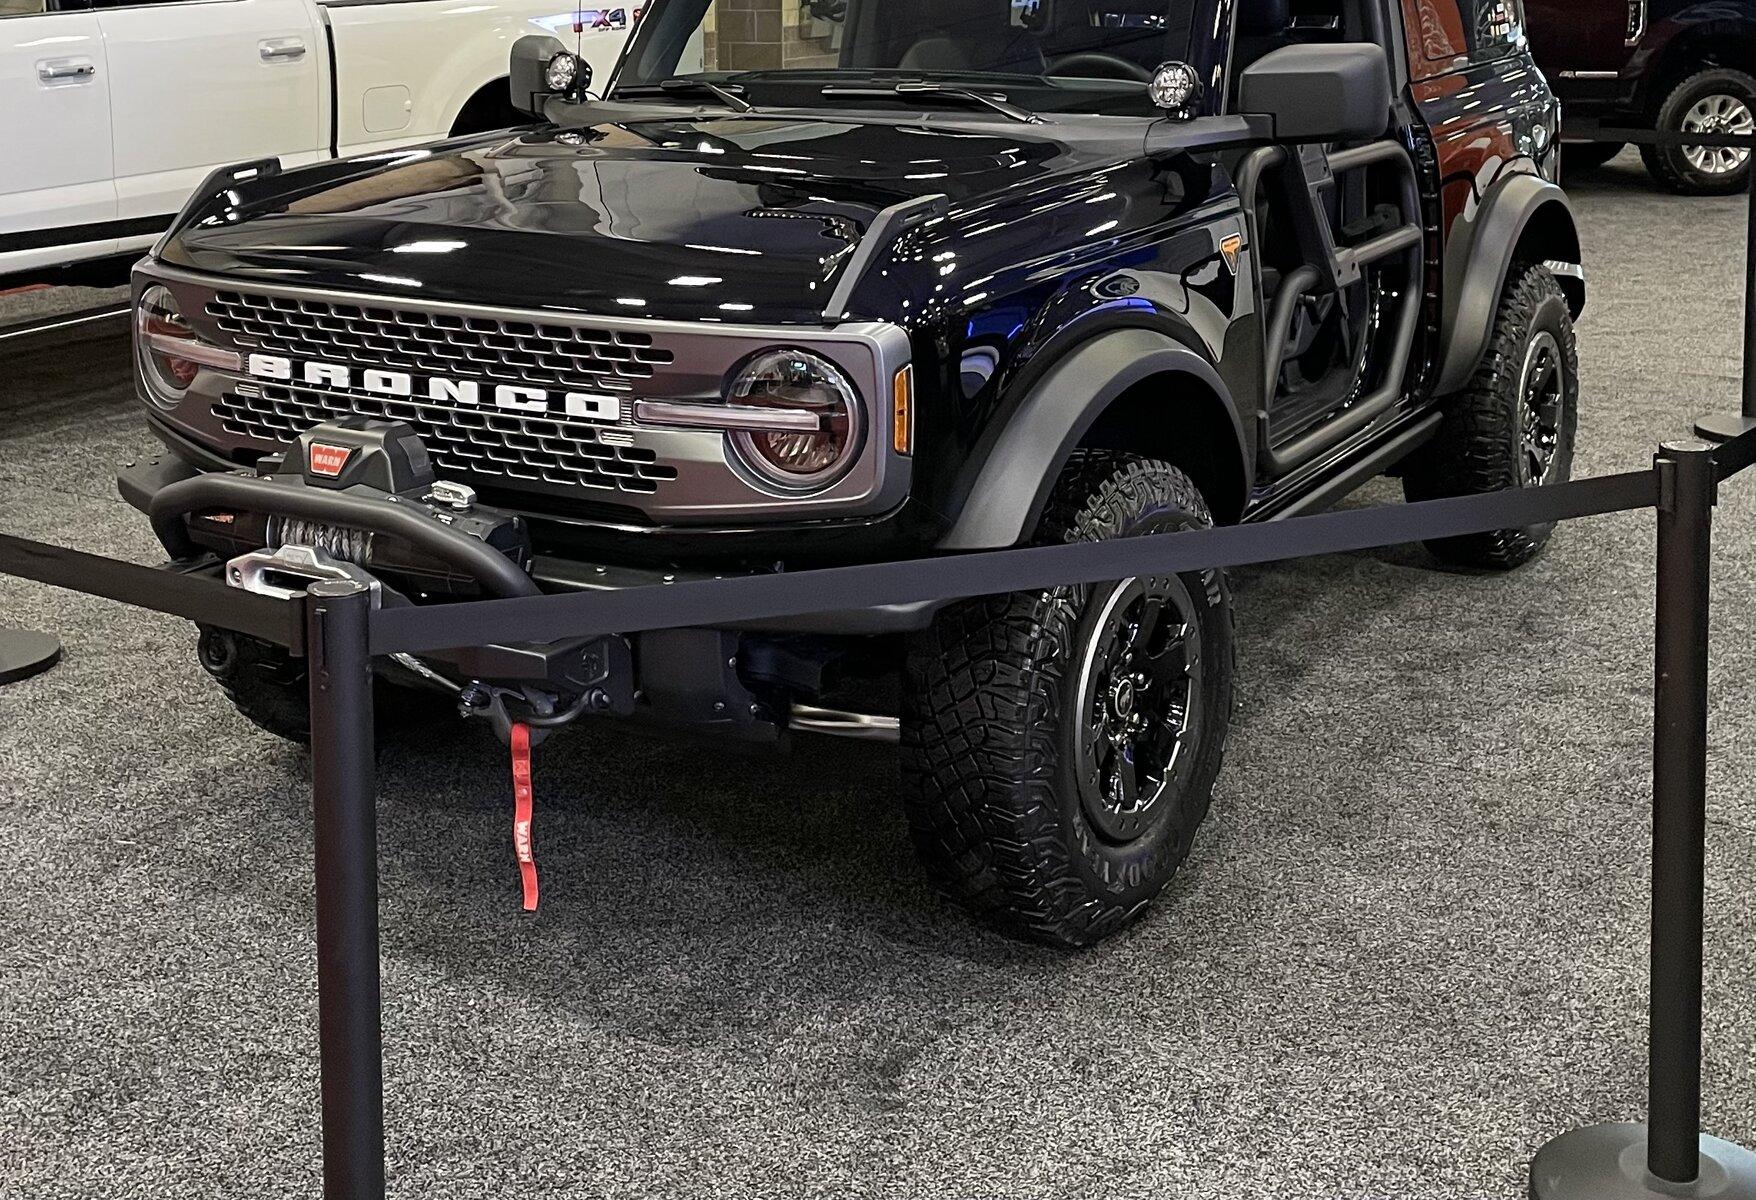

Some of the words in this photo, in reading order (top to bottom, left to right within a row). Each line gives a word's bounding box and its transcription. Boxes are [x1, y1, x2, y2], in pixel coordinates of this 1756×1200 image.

[572, 8, 626, 32] FX4
[248, 353, 620, 420] BRONCO
[314, 453, 341, 467] WARN
[516, 820, 531, 862] WARN
